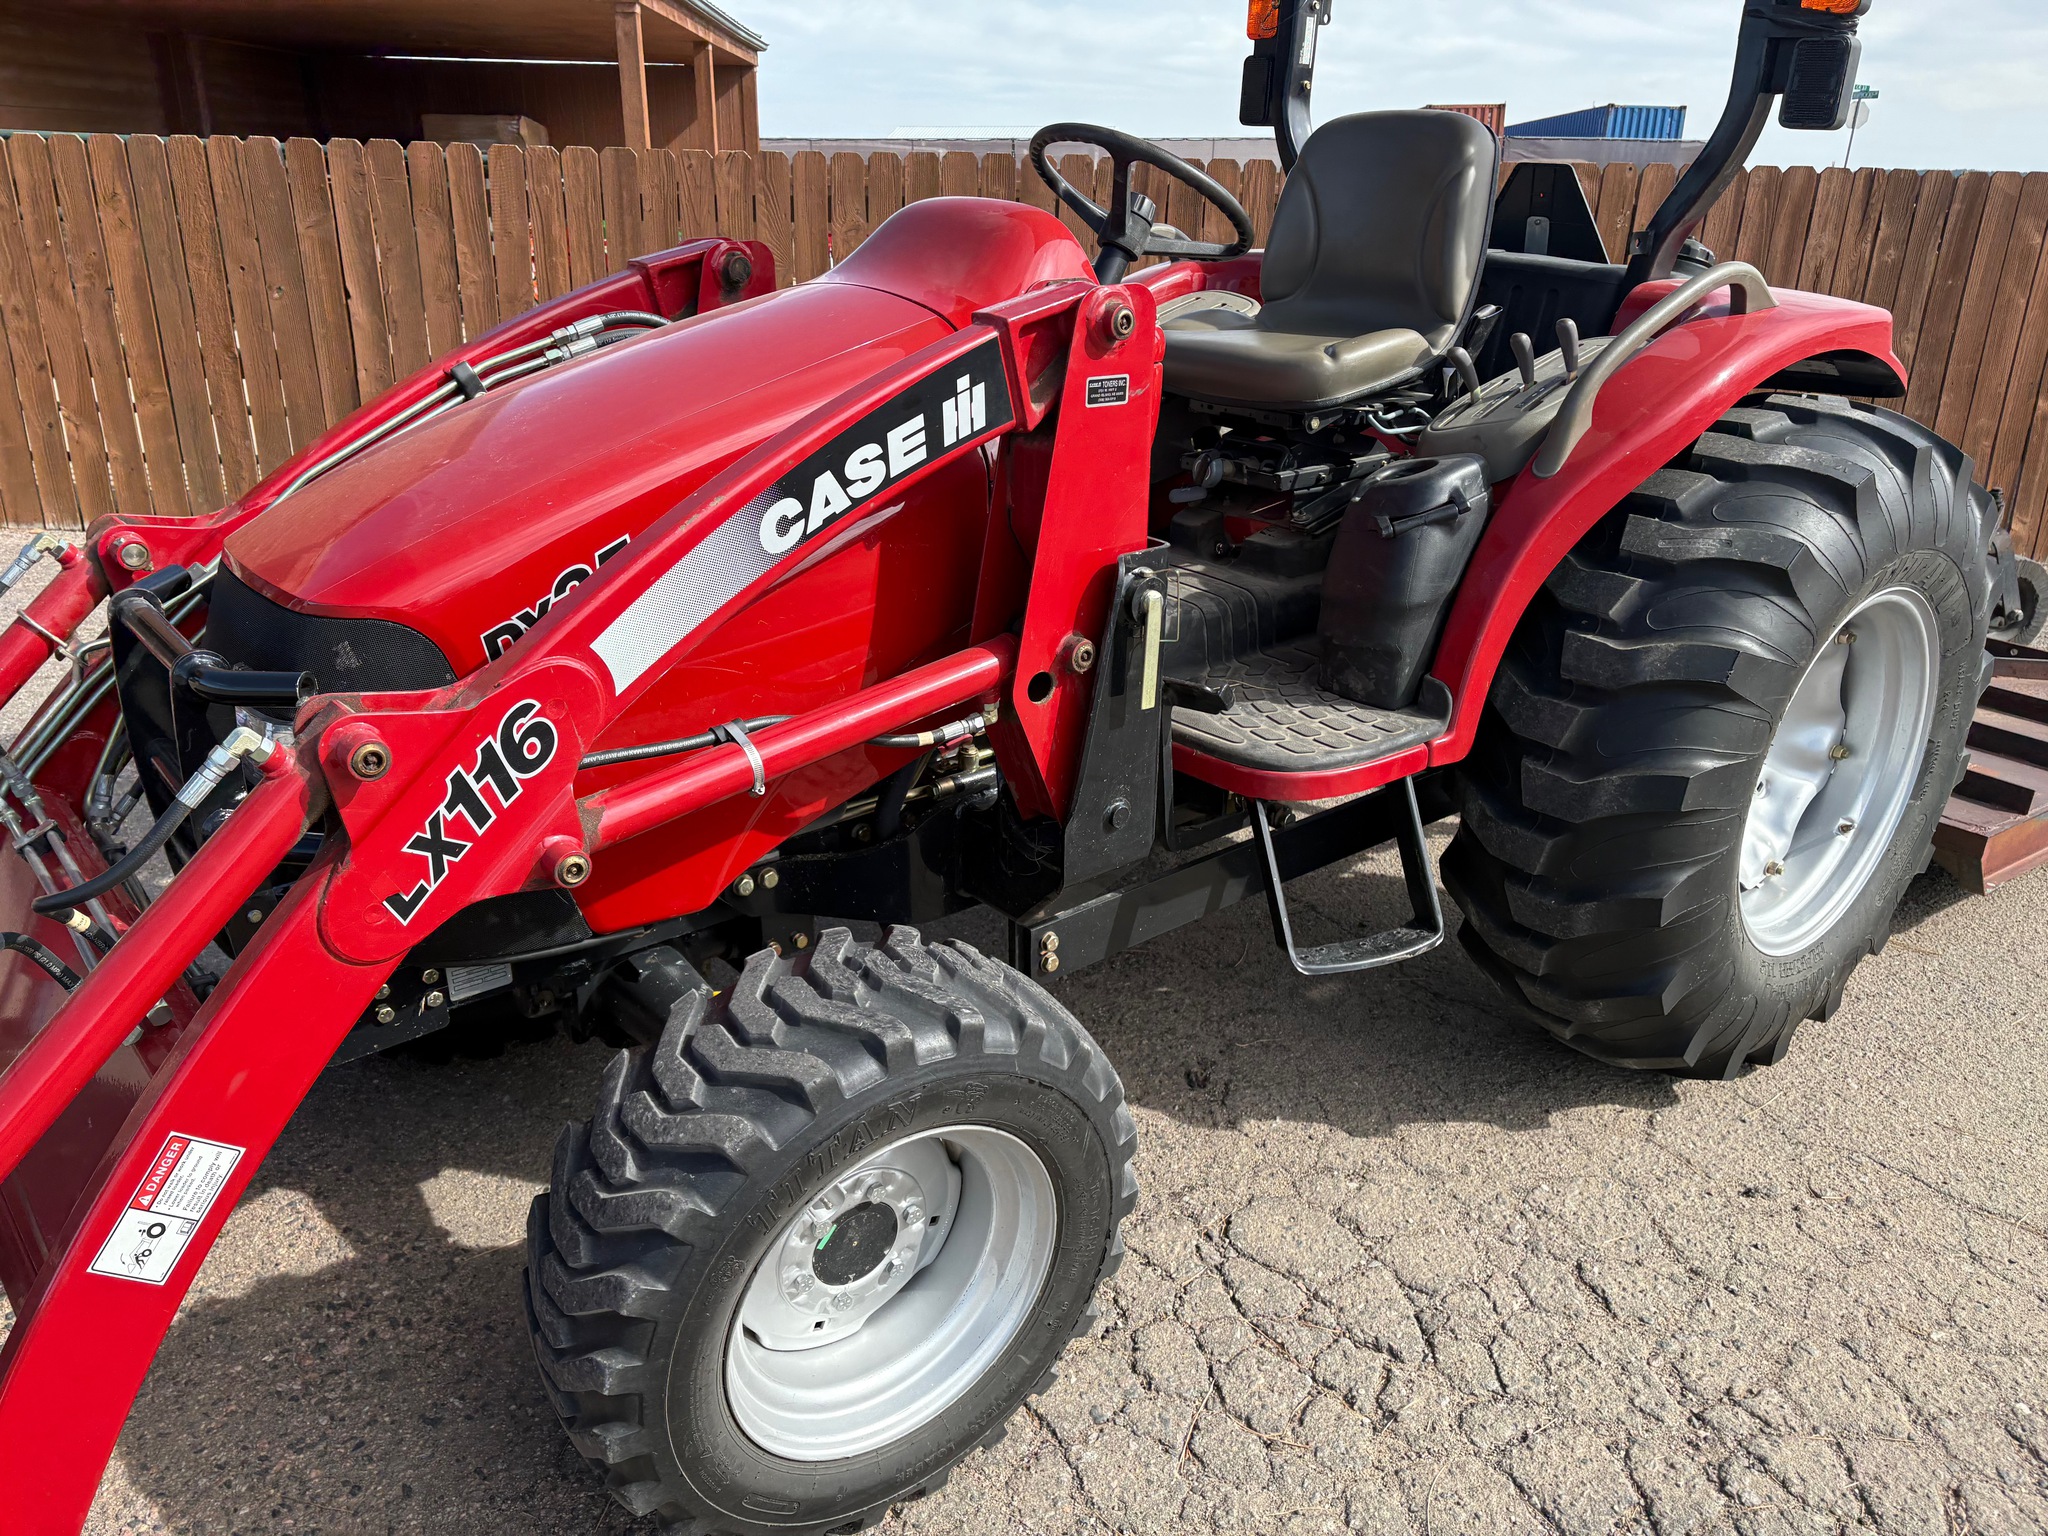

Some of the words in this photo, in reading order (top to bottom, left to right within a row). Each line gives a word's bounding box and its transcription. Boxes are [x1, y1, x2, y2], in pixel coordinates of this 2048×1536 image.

[759, 412, 927, 554] CASE
[383, 698, 559, 926] LX116
[145, 1142, 183, 1192] DANGER
[167, 1179, 175, 1189] walk
[178, 1161, 186, 1172] work
[170, 1193, 179, 1207] Lower
[178, 1179, 188, 1192] loader
[191, 1156, 203, 1172] ground
[182, 1191, 198, 1211] Failure
[200, 1162, 216, 1183] comply
[214, 1151, 222, 1161] will
[747, 1093, 923, 1236] TITAN
[189, 1195, 202, 1212] result
[205, 1170, 217, 1188] death
[196, 1192, 212, 1213] serious
